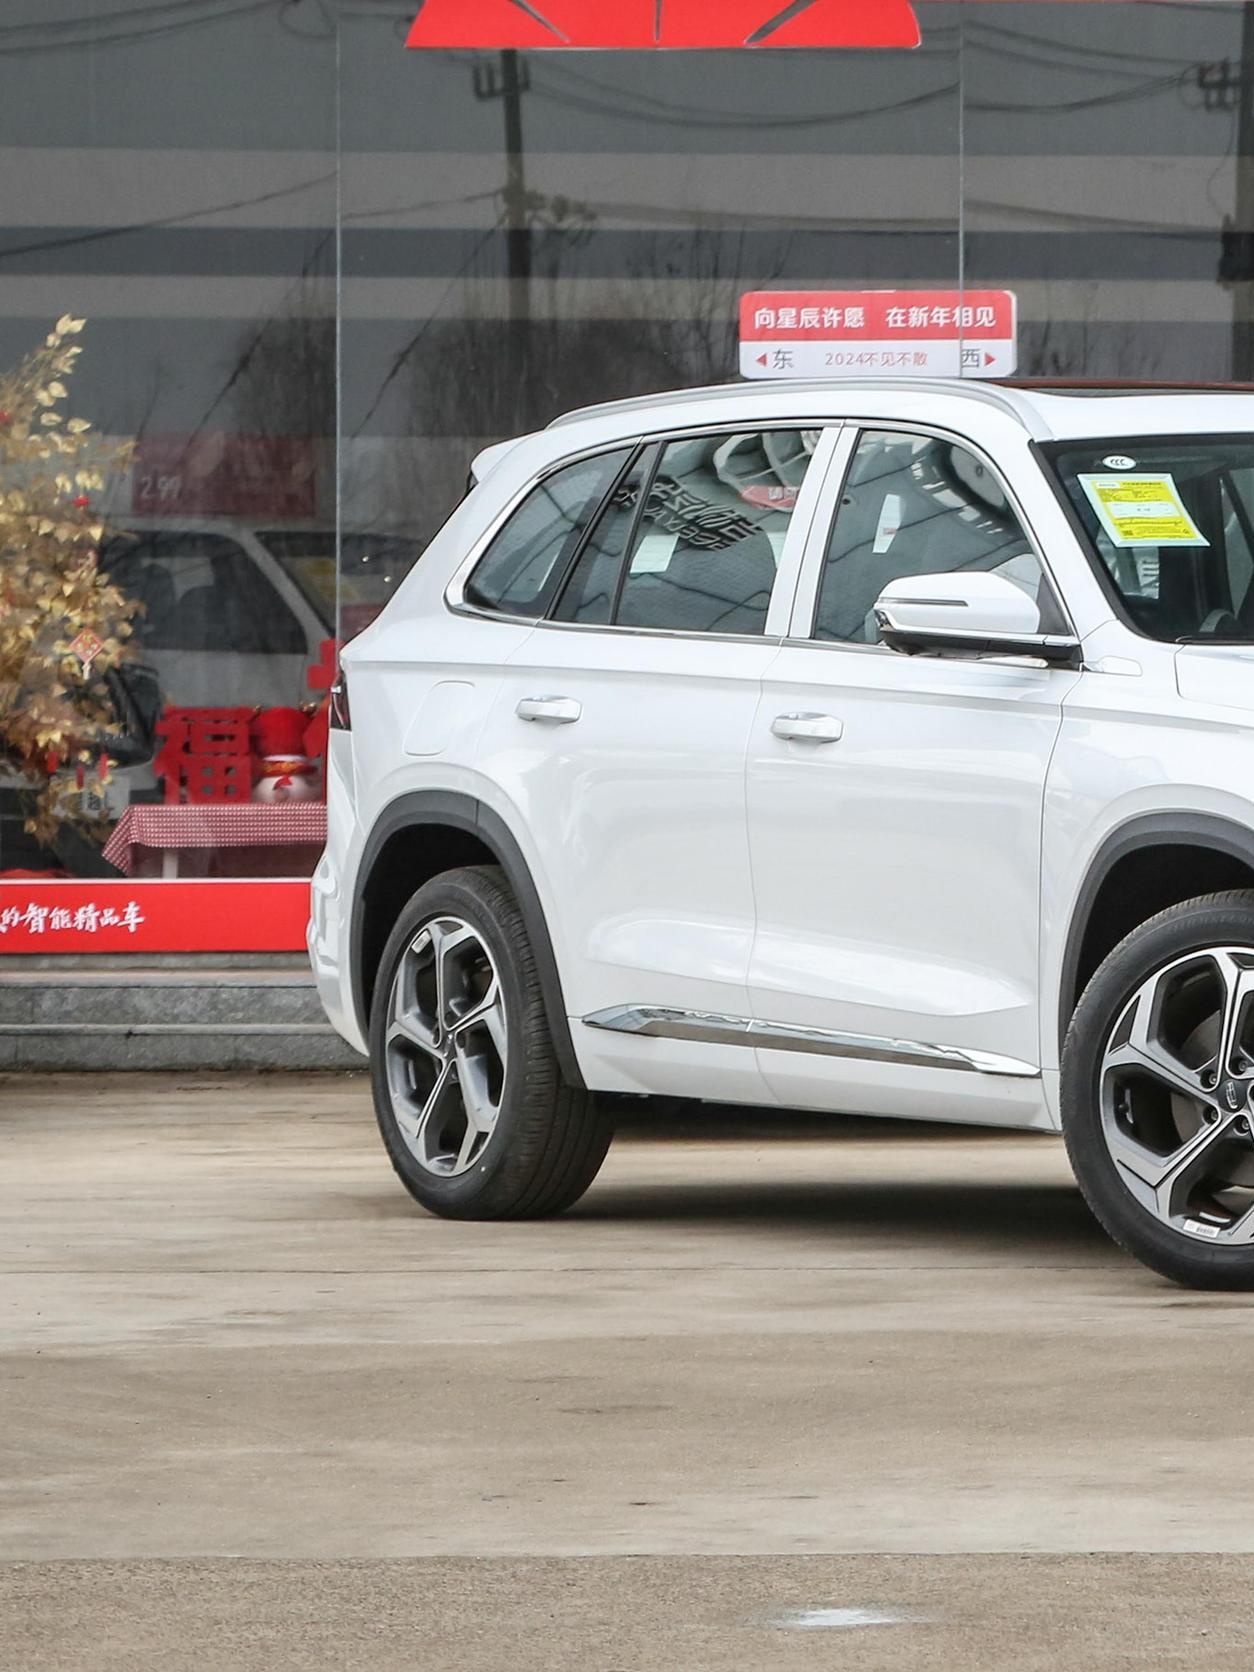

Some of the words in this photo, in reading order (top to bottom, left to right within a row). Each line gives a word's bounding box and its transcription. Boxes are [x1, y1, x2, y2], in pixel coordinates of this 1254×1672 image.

[754, 307, 865, 329] 向星辰许愿
[885, 306, 996, 328] 在新年相见
[772, 349, 794, 371] 东
[961, 349, 981, 370] 西
[153, 704, 251, 805] 福
[0, 901, 145, 933] 的智能精品车
